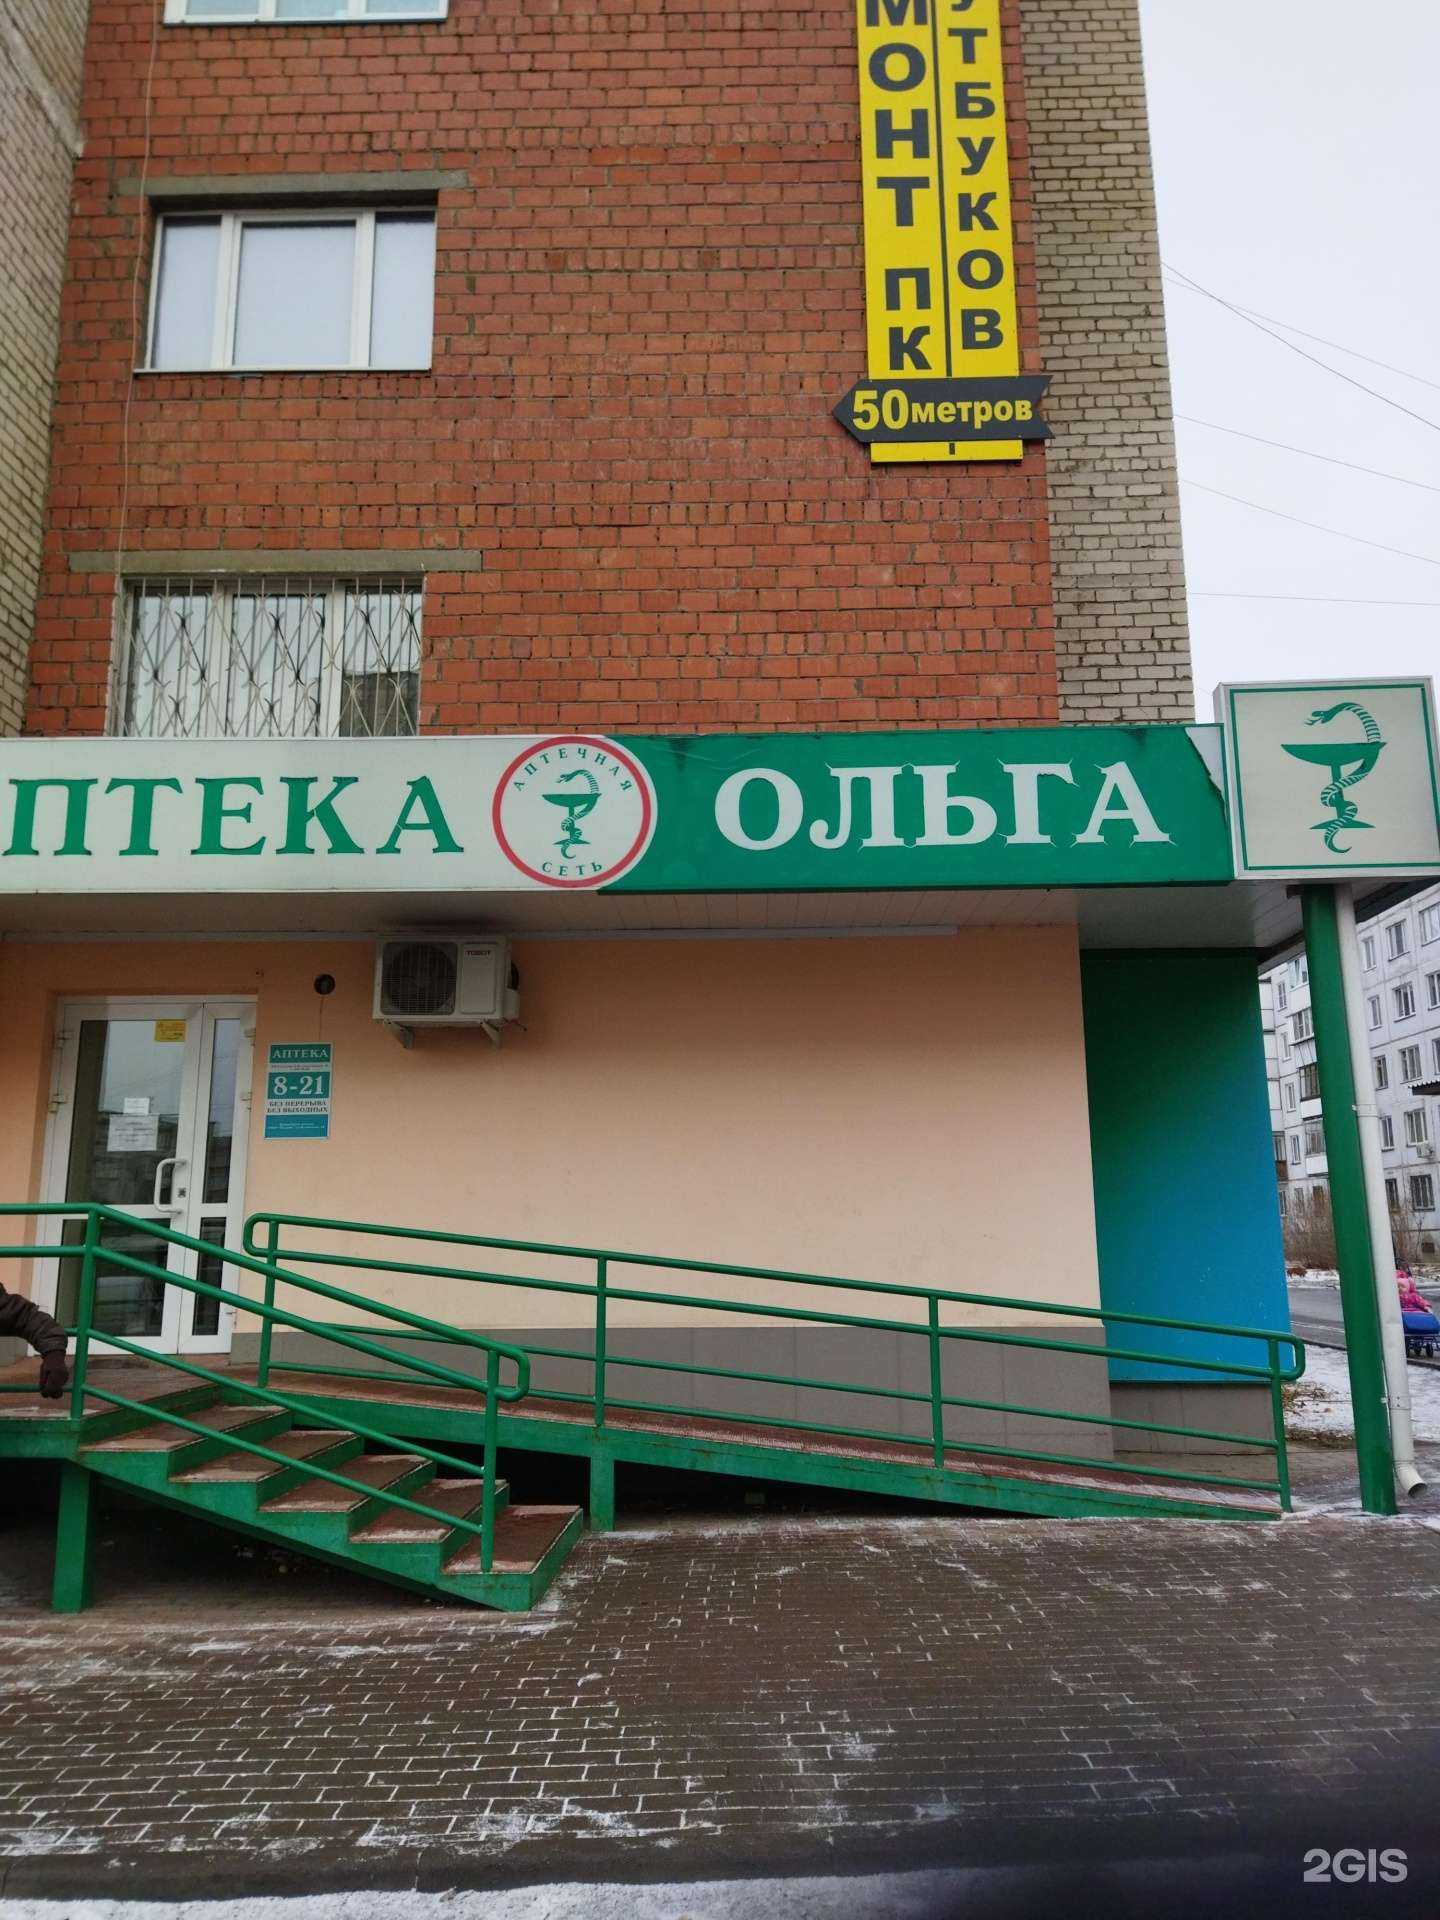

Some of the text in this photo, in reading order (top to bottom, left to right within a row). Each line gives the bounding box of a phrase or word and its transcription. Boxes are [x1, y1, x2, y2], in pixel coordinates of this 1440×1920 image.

[885, 268, 932, 371] ПК
[514, 747, 632, 791] АПТЕЧНАЯ
[2, 776, 464, 856] ПТЕКА
[714, 760, 1174, 850] ОЛЬГА
[542, 861, 602, 876] СЕТЬ
[272, 1049, 329, 1059] АПТЕКА
